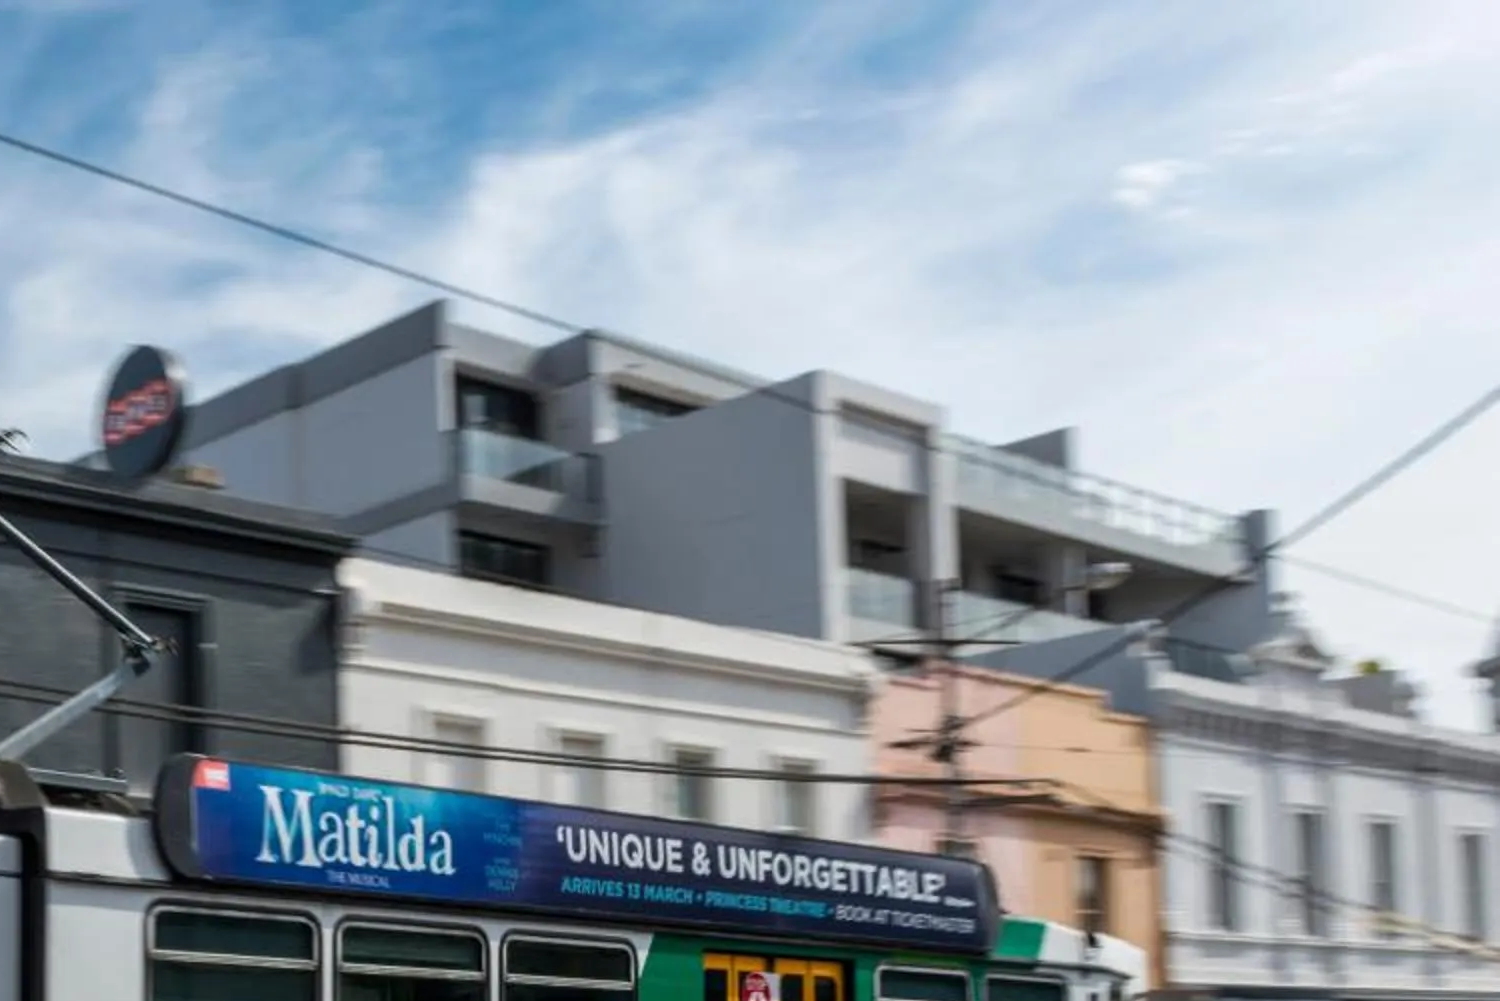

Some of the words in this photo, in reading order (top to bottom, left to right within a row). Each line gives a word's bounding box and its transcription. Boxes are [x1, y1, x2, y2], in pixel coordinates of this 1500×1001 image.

[255, 784, 457, 875] Matilda
[691, 841, 711, 877] &
[560, 875, 624, 898] ARRIVES
[627, 883, 641, 900] 13
[644, 884, 693, 905] MARCH
